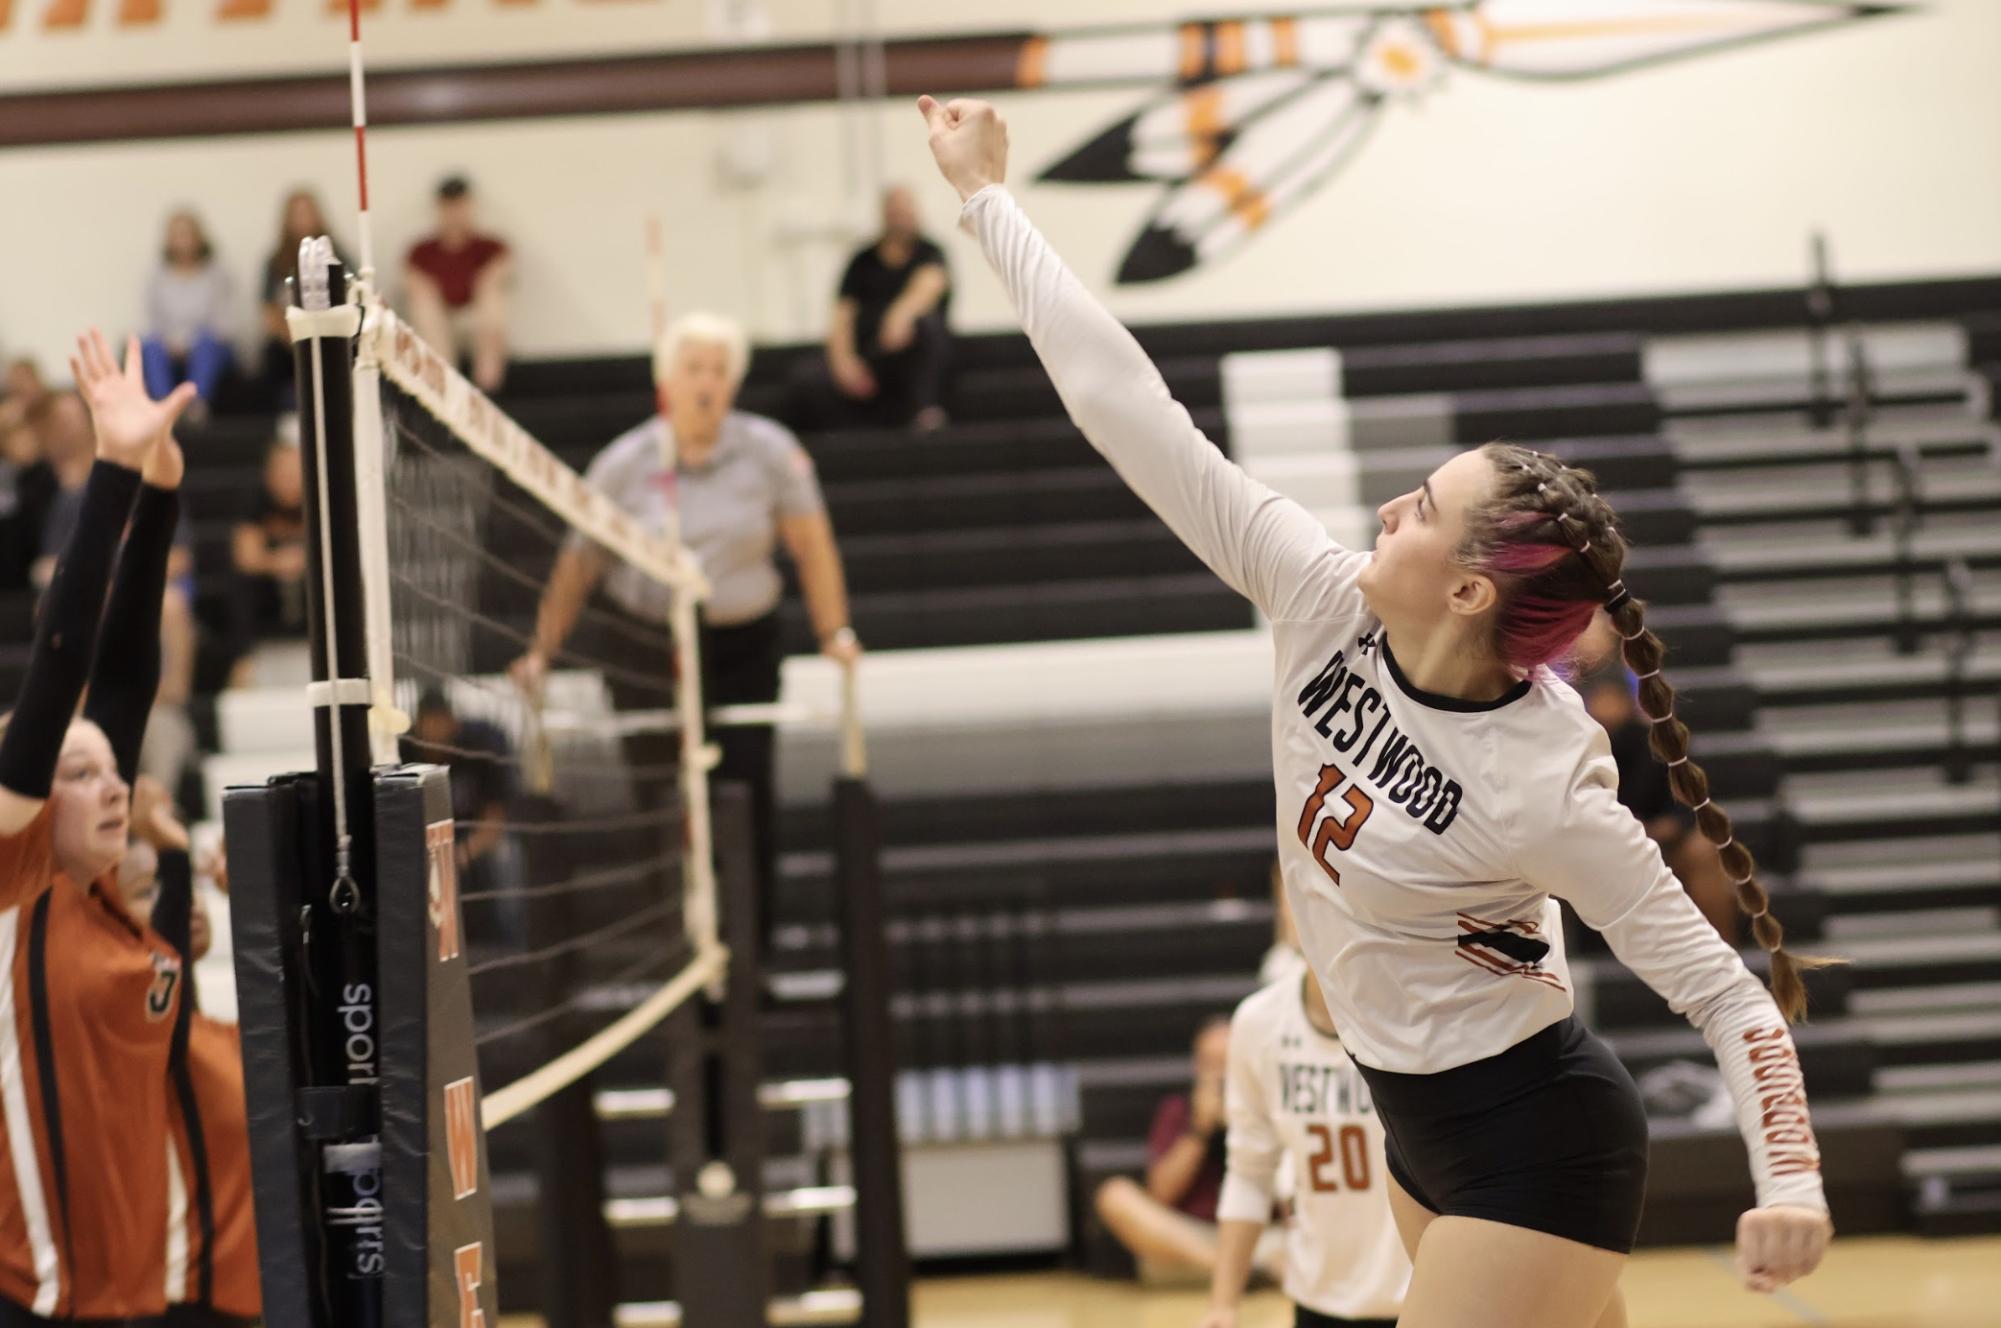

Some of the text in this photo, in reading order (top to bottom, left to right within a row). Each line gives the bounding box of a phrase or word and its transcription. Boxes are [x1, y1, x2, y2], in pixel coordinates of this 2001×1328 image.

[1298, 651, 1463, 836] WESTWOOD
[1297, 763, 1374, 888] 12
[337, 983, 379, 1085] sport
[1306, 1123, 1372, 1192] 20
